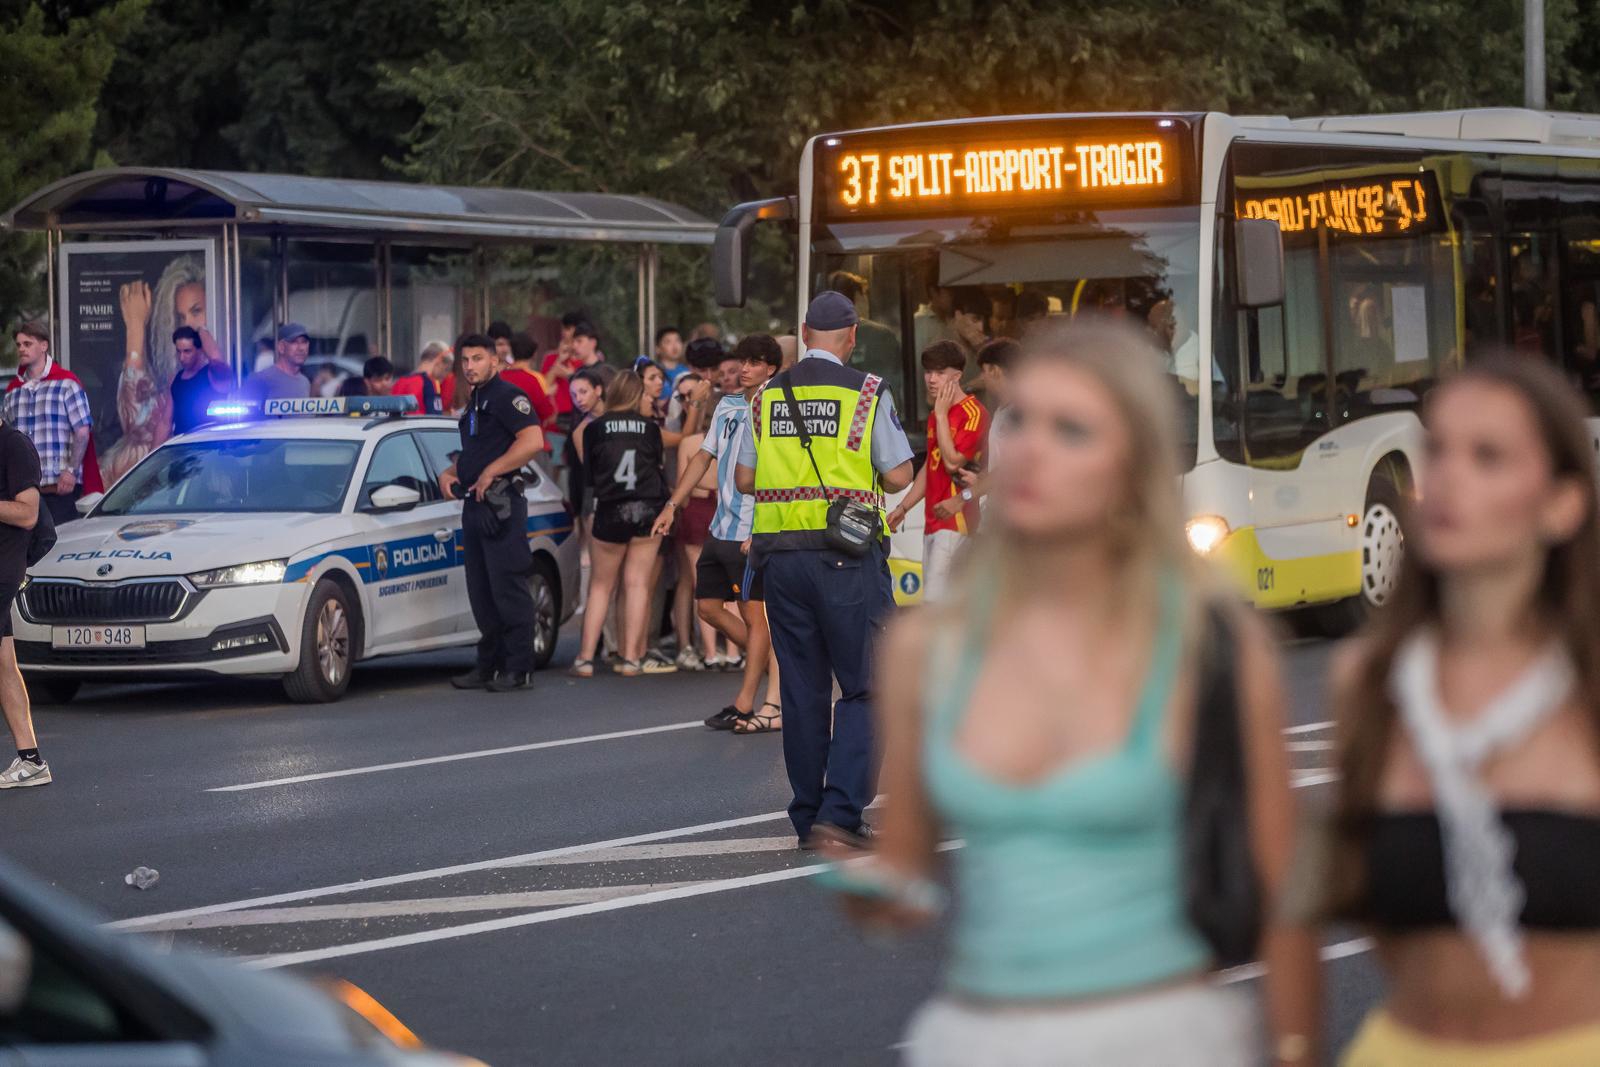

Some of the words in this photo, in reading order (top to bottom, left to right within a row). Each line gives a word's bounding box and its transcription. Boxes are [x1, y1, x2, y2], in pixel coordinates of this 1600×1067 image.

[842, 154, 880, 205] 37
[889, 141, 1164, 198] SPLIT-AIRPORT-TROGIR
[269, 399, 340, 413] POLICIJA
[773, 402, 836, 417] PRMETNO
[605, 420, 646, 434] SUMMIT
[723, 417, 739, 440] 19
[771, 419, 838, 435] REDSTVO
[613, 449, 638, 491] 4
[57, 549, 173, 563] POLICIJA
[393, 543, 447, 568] POLICIJA
[1257, 568, 1275, 591] 021
[66, 628, 92, 645] 120
[104, 628, 131, 645] 948
